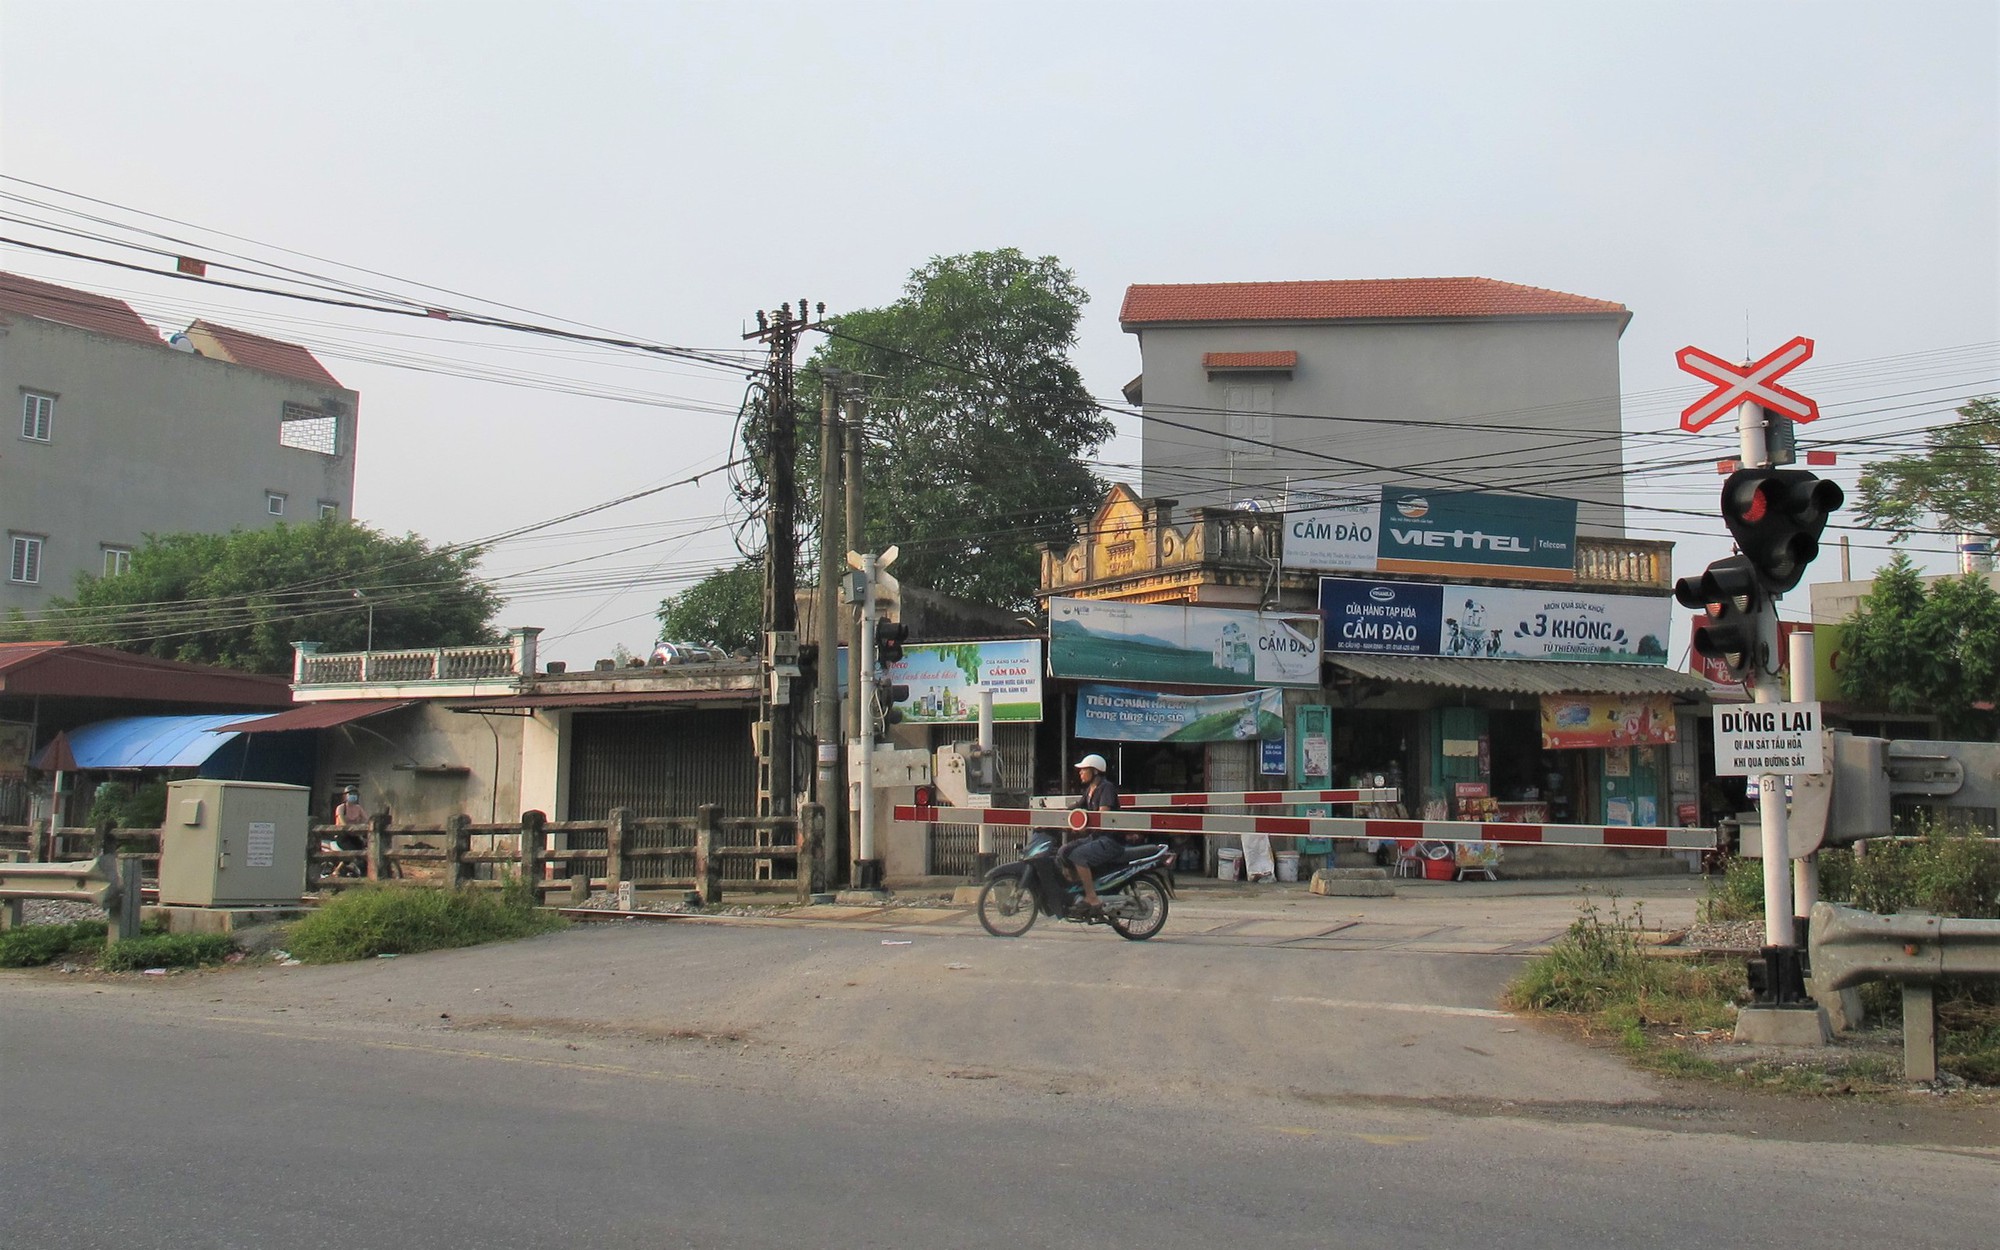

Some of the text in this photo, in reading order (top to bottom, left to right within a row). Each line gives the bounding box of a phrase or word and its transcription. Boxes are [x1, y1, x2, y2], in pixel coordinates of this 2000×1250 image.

[1293, 517, 1372, 542] CẨM ĐÀO
[1389, 528, 1567, 552] VIETTEL Telecom
[1346, 602, 1416, 619] CỬA HÀNG TẠP HÓA
[1561, 600, 1574, 610] QUÀ
[1343, 616, 1417, 641] CẨM ĐÀO
[1533, 613, 1612, 640] 3 KHÔNG
[1259, 630, 1286, 651] CẨM
[1543, 641, 1599, 654] TỪ THIÊN NHIÊN
[990, 665, 1007, 675] CẨM
[1086, 694, 1112, 706] TIÊU
[1086, 709, 1117, 721] trong
[1145, 712, 1165, 724] hộp
[1721, 708, 1812, 736] DỪNG LẠI
[1734, 740, 1754, 750] QUAN
[1756, 737, 1769, 749] SÁT
[1734, 752, 1805, 768] KHI QUA ĐƯỜNG SẮT
[1763, 780, 1776, 792] Đ1
